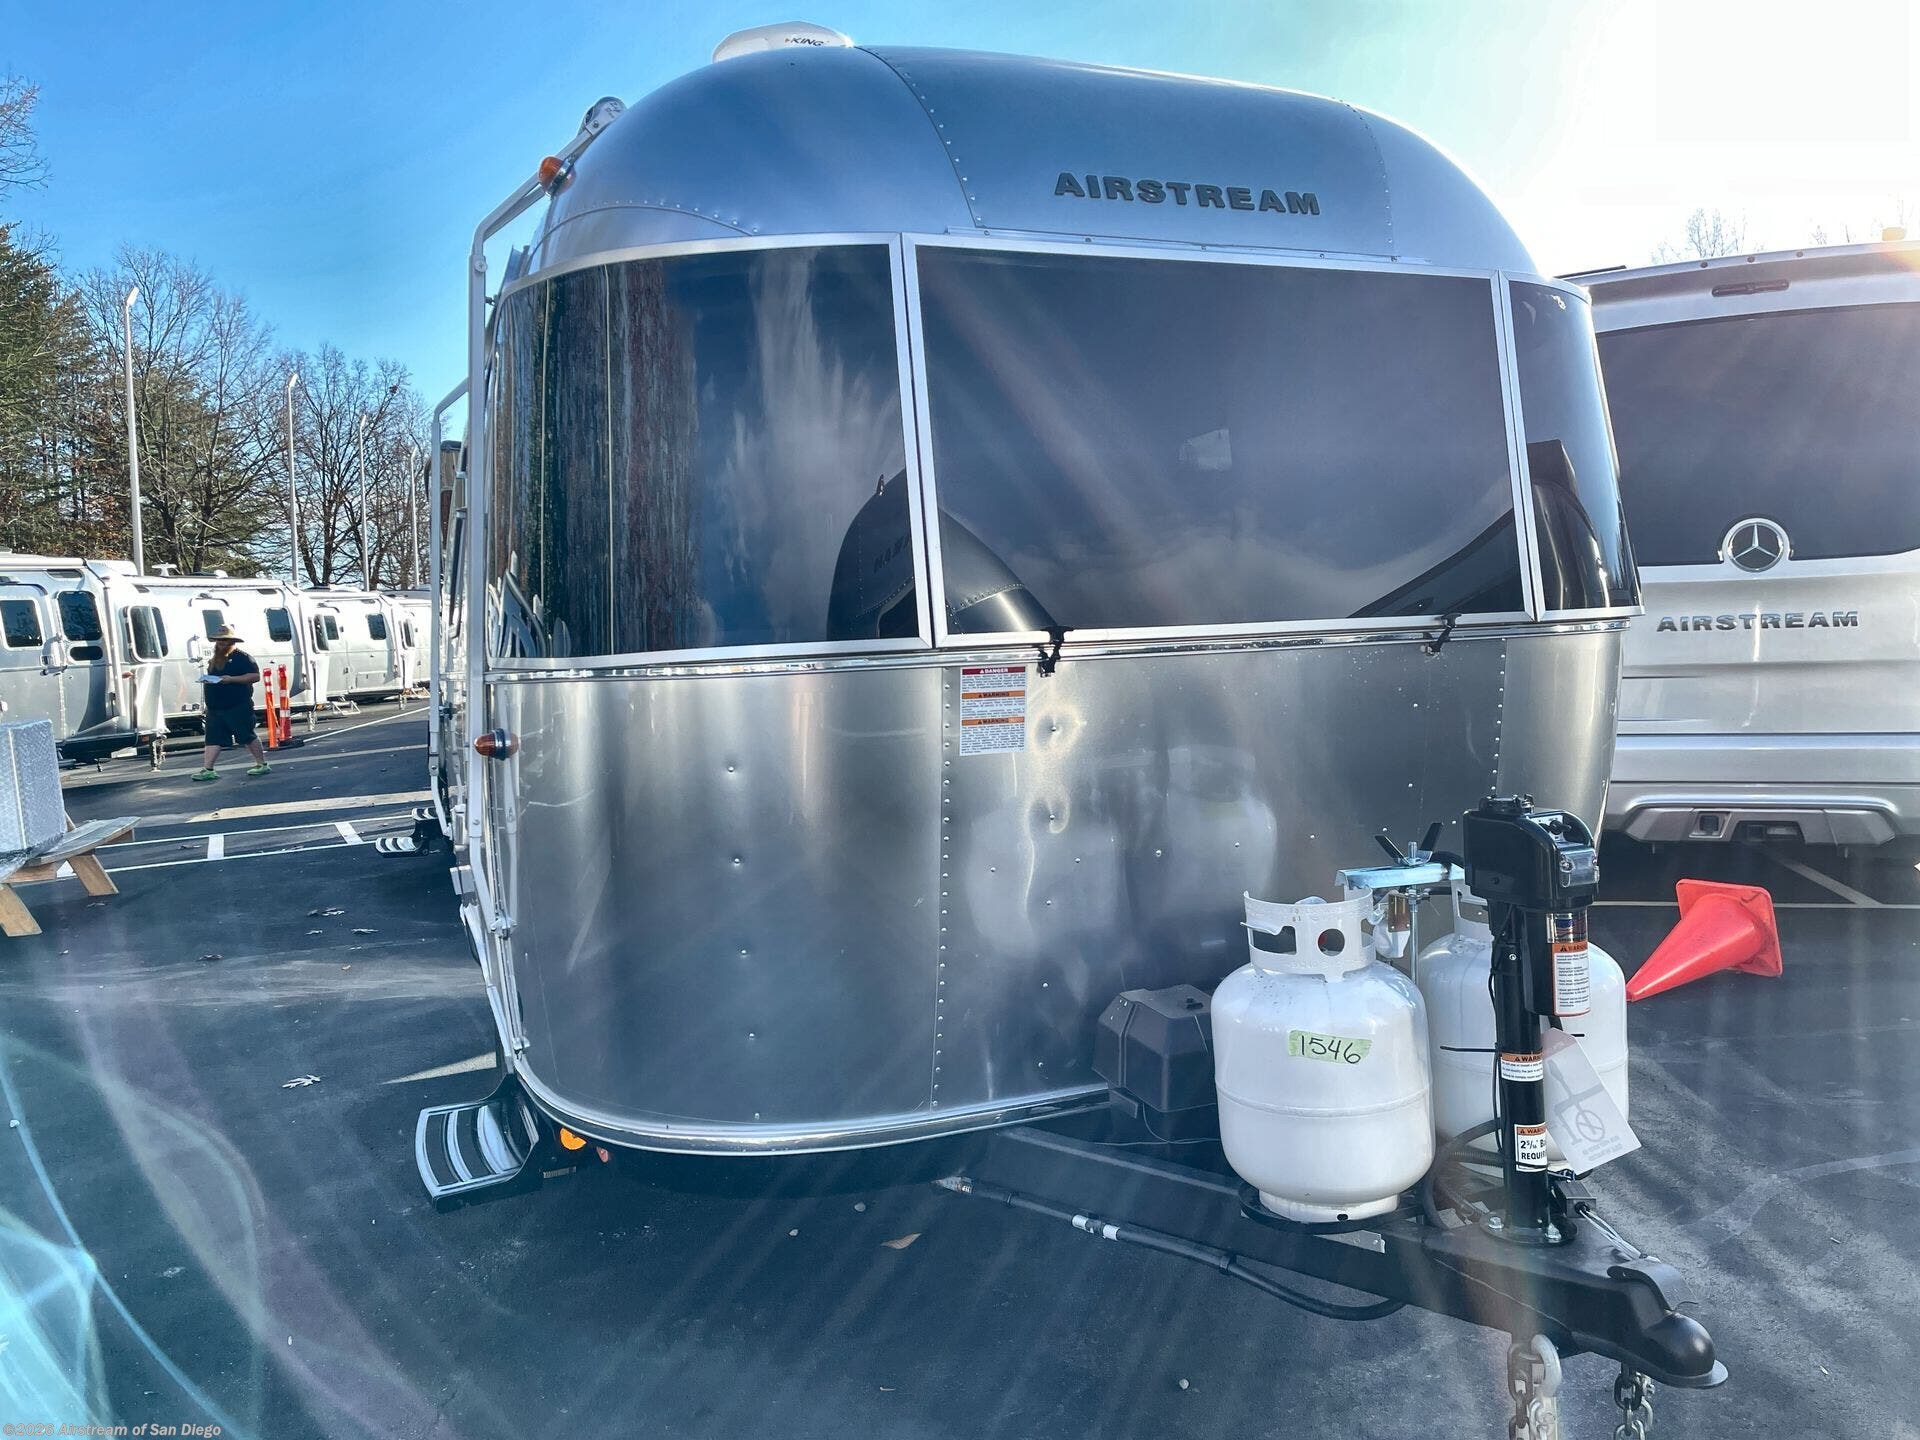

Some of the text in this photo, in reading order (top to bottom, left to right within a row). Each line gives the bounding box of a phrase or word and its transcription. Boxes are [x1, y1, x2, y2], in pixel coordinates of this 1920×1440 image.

[1054, 171, 1321, 216] AIRSTREAM
[1656, 611, 1859, 632] AIRSTREAM
[1301, 1034, 1361, 1065] 1546
